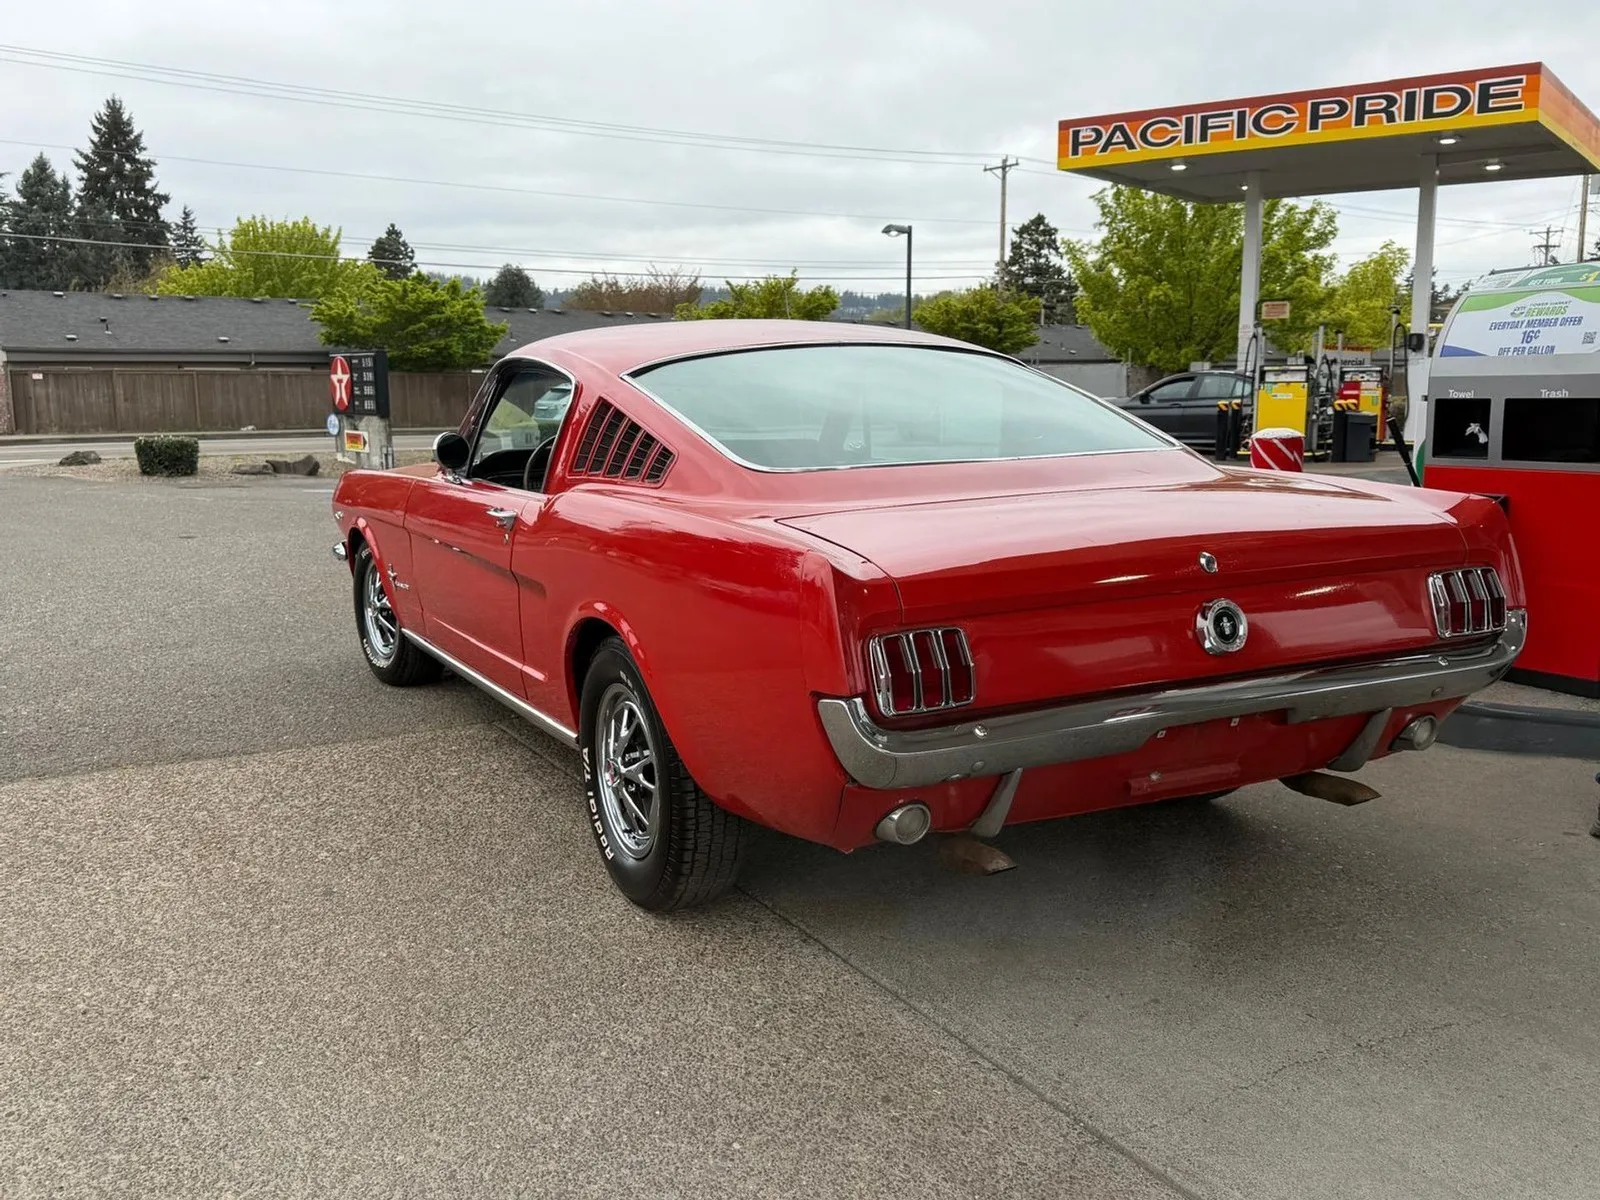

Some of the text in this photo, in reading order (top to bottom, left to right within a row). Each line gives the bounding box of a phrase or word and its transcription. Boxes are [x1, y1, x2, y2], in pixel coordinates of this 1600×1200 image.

[1069, 76, 1527, 158] PACIFIC PRIDE
[1525, 305, 1569, 317] REWARDS
[1489, 316, 1583, 331] EVERYDAY MEMBER OFFER
[1498, 345, 1556, 356] OFF PER GALLON
[1448, 389, 1475, 398] Towel
[1540, 388, 1569, 398] Trash
[582, 747, 614, 861] Radial T/A
